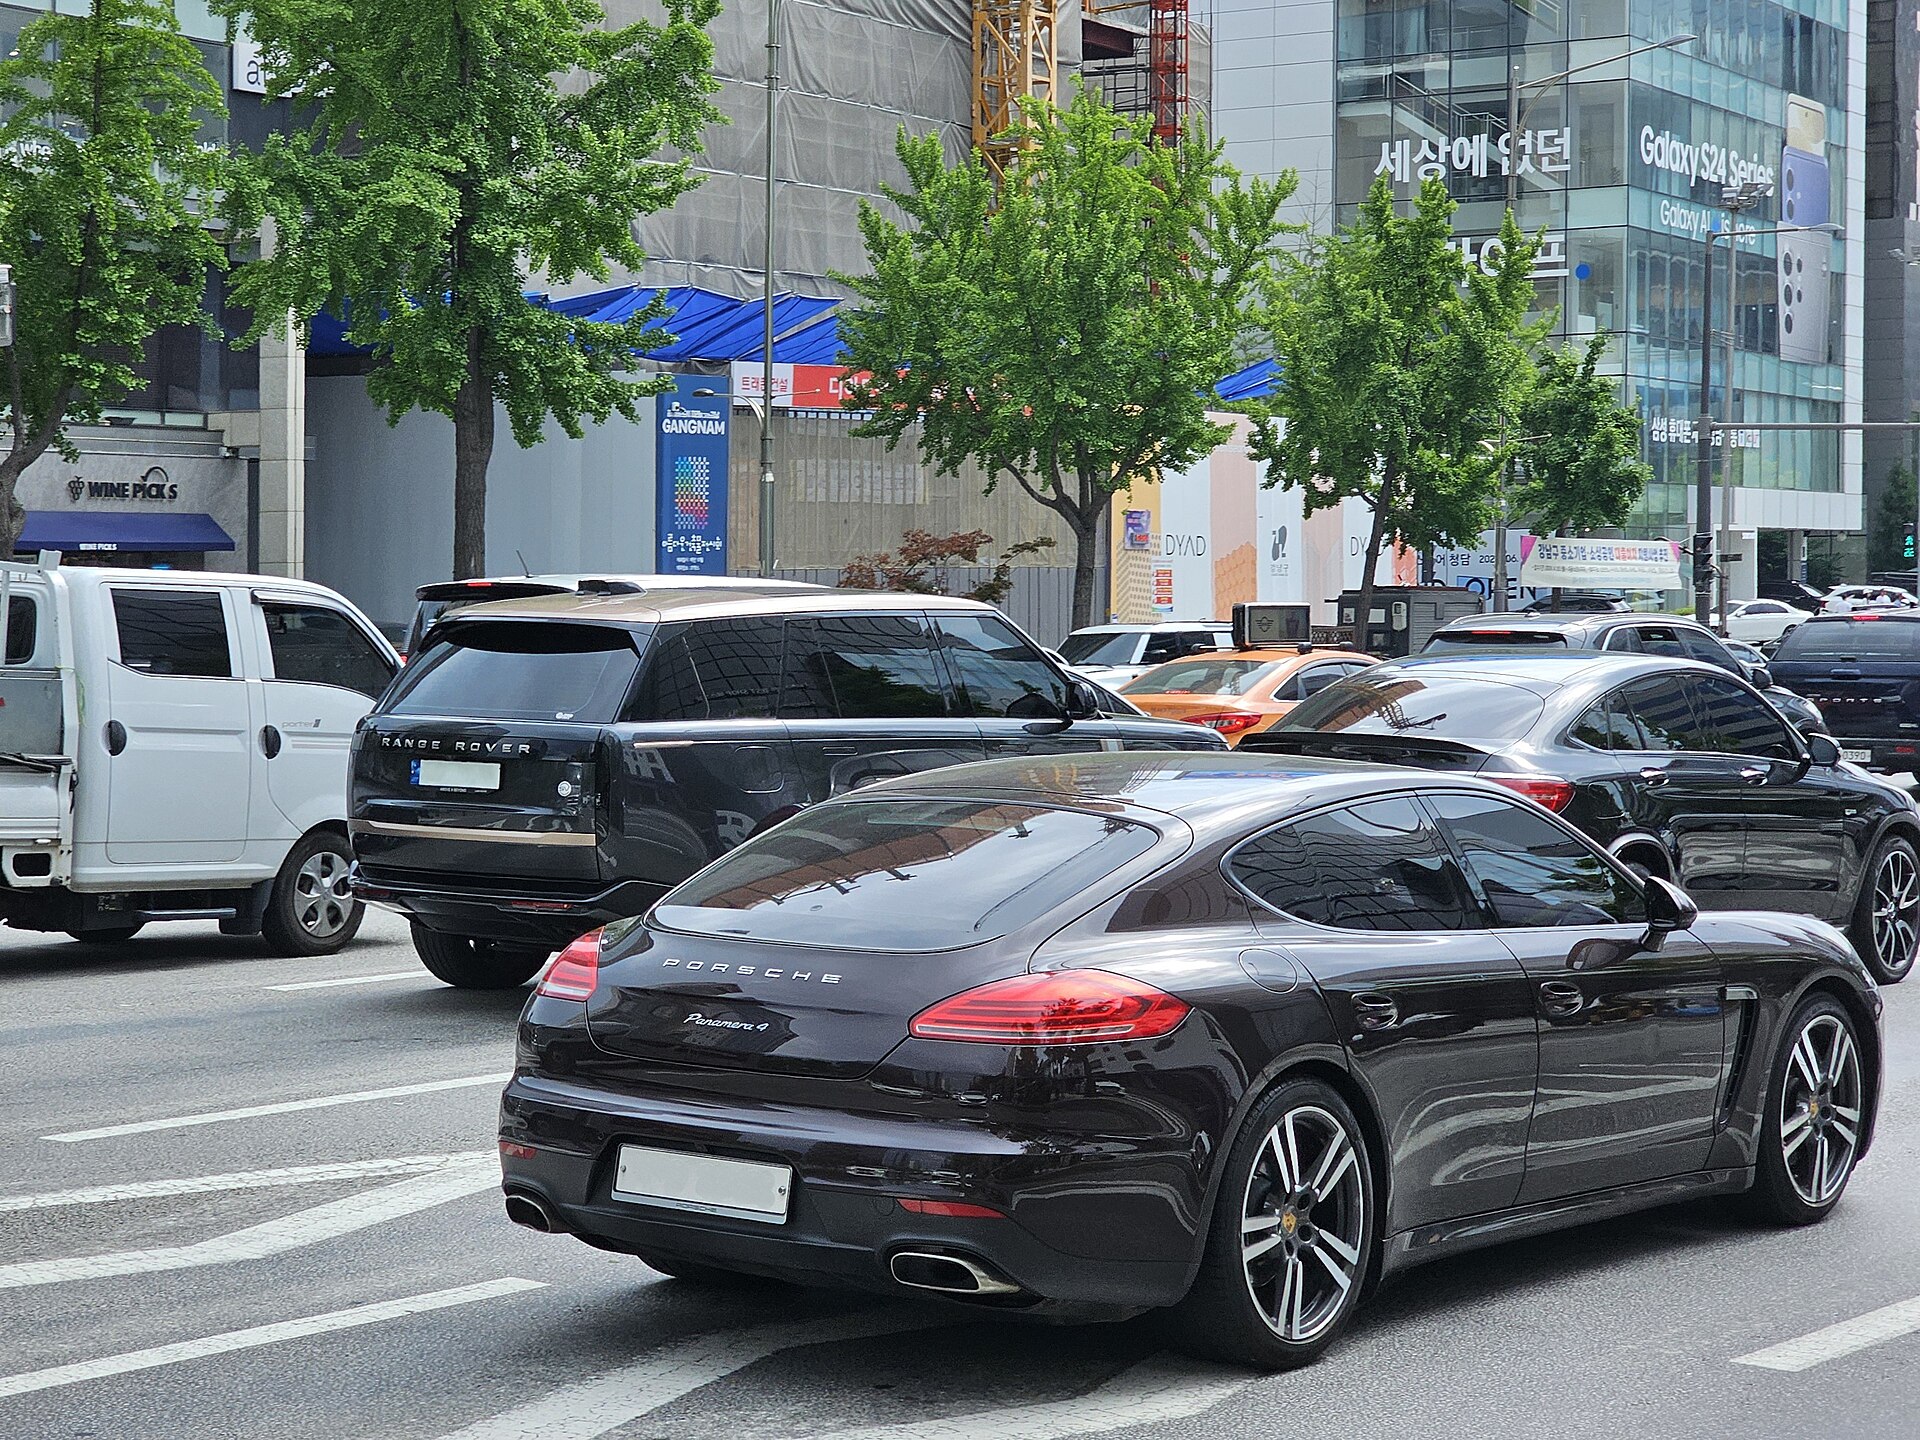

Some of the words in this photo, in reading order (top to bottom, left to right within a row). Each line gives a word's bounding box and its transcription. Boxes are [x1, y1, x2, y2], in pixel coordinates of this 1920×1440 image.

[1374, 133, 1489, 184] 세상에
[1498, 127, 1571, 176] 없던
[1640, 124, 1700, 188] Galaxy
[1700, 142, 1727, 185] S24
[1728, 150, 1775, 198] Series
[1660, 199, 1700, 241] Galaxy
[661, 418, 726, 435] GANGNAM
[87, 482, 129, 498] WINE
[132, 483, 178, 500] PICKS
[1165, 534, 1206, 556] DYAD
[1538, 543, 1559, 560] 강남구
[1449, 553, 1471, 567] 청담
[381, 737, 442, 750] RANGE
[455, 741, 531, 754] ROVER
[662, 957, 843, 985] PORSCHE
[683, 1012, 755, 1031] Panamera
[756, 1022, 770, 1032] 4
